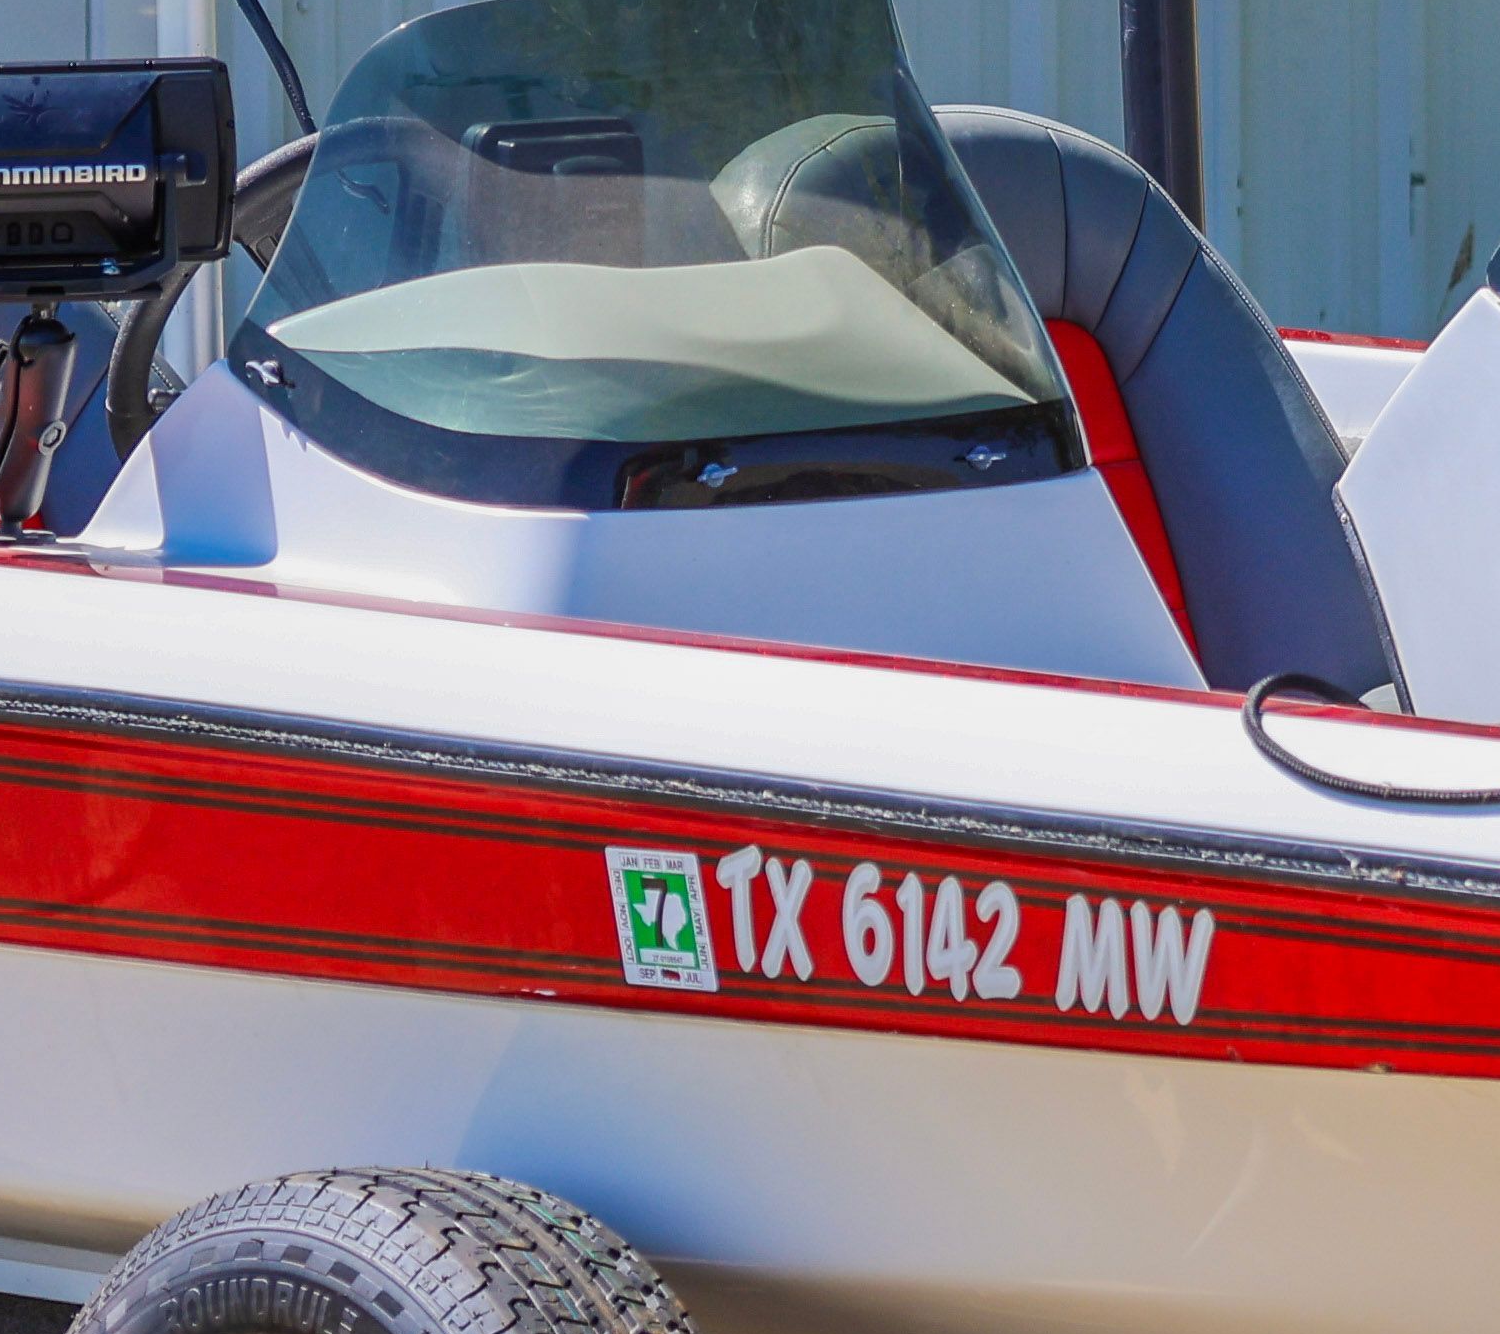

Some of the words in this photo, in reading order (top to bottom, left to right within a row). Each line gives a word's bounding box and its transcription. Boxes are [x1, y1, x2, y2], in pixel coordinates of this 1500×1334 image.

[621, 856, 638, 868] JAN
[643, 857, 661, 869] FEB
[665, 860, 683, 870] MAR
[613, 871, 624, 894] DEC
[687, 876, 699, 900] APR
[641, 875, 668, 948] 7
[692, 910, 703, 936] MAY
[716, 844, 814, 982] TX
[842, 861, 1023, 1003] 6142
[1055, 892, 1217, 1026] MW
[623, 938, 635, 963] OCT
[698, 944, 709, 969] JUN
[639, 968, 656, 979] SEP
[685, 972, 701, 984] JUL
